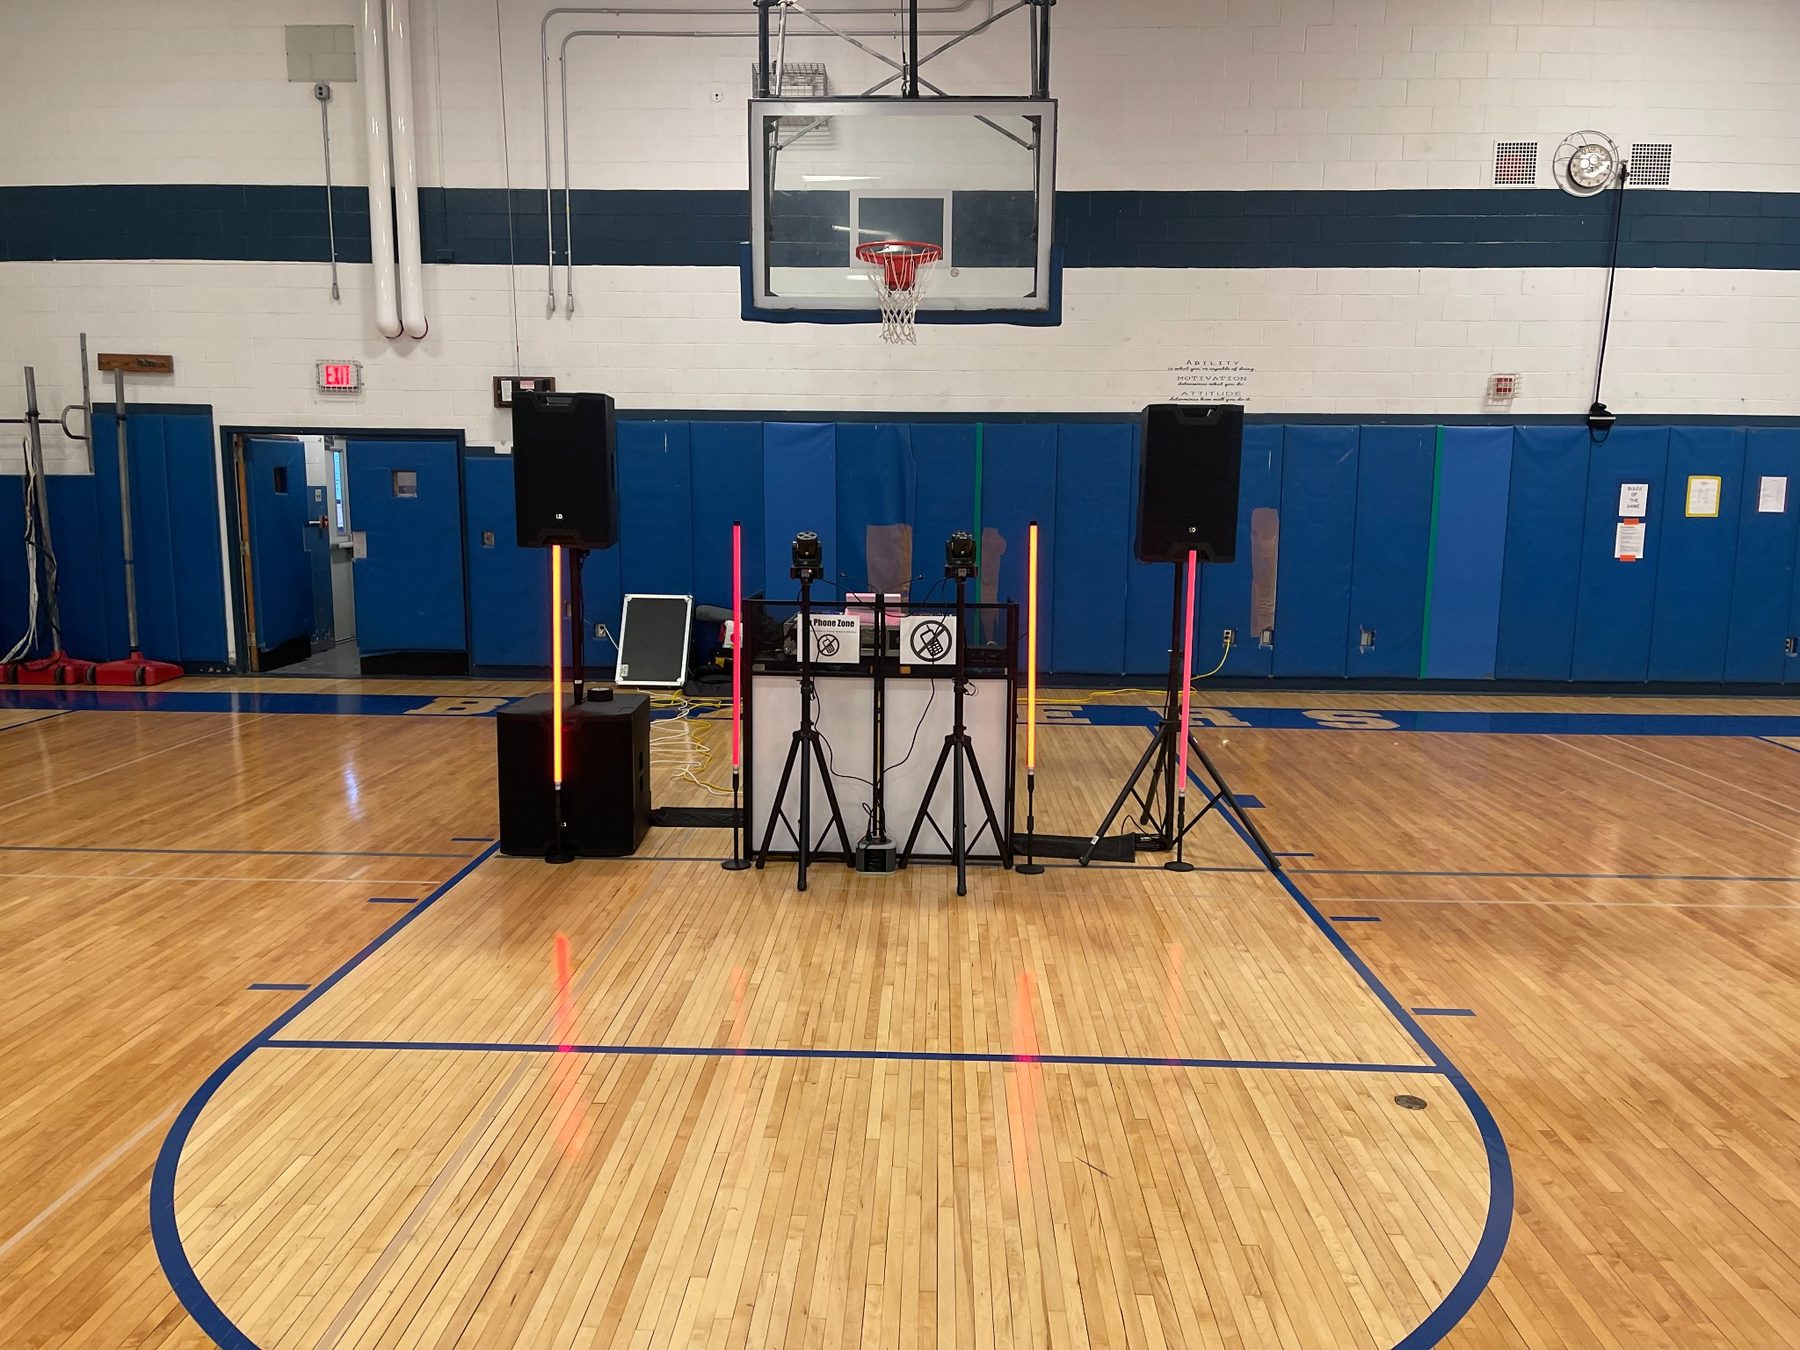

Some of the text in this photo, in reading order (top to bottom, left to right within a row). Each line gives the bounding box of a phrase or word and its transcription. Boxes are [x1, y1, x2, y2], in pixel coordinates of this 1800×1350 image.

[325, 365, 350, 385] EXIT
[813, 619, 855, 627] Phone Zone
